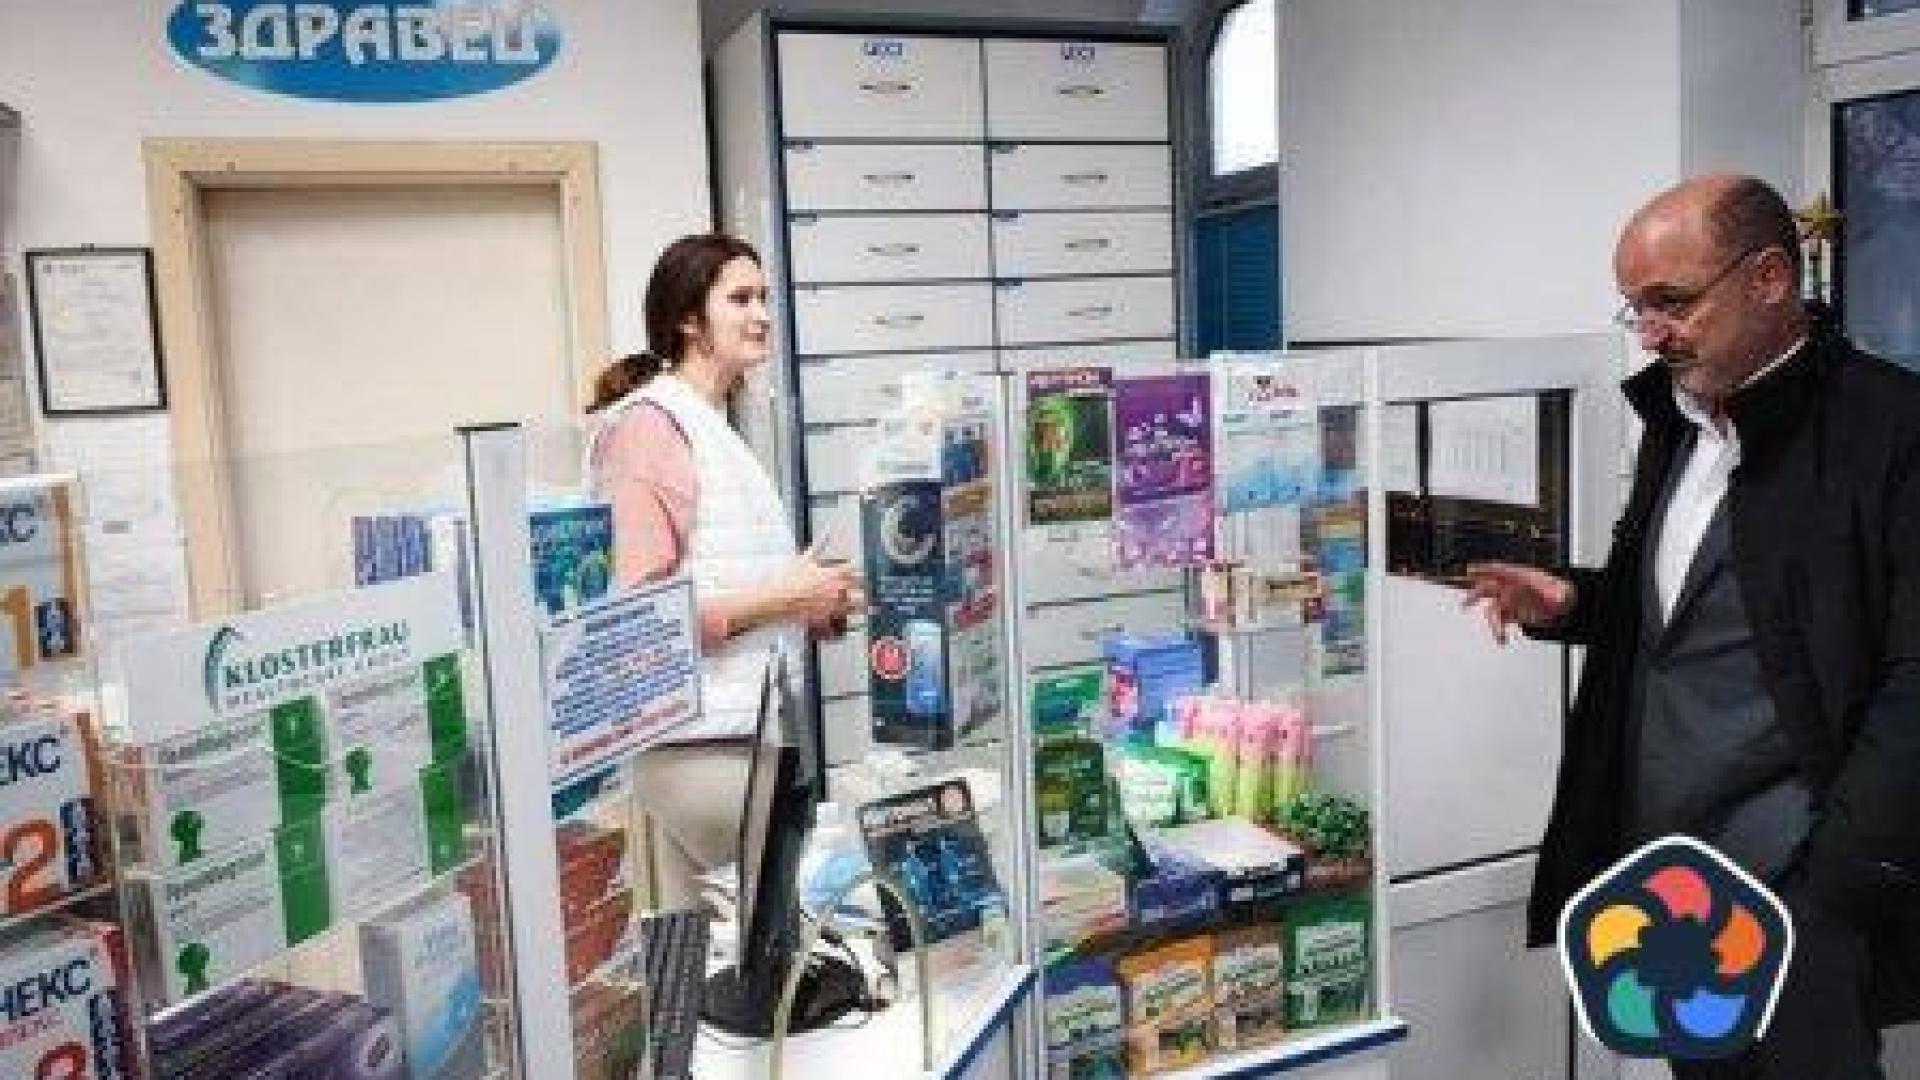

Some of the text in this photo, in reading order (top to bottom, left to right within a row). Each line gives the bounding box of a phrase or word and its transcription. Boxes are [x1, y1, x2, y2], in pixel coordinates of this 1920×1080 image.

[197, 2, 541, 65] ЗДРАВЕЦ
[225, 619, 410, 689] KLOSTERFRAU
[3, 819, 58, 913] 2
